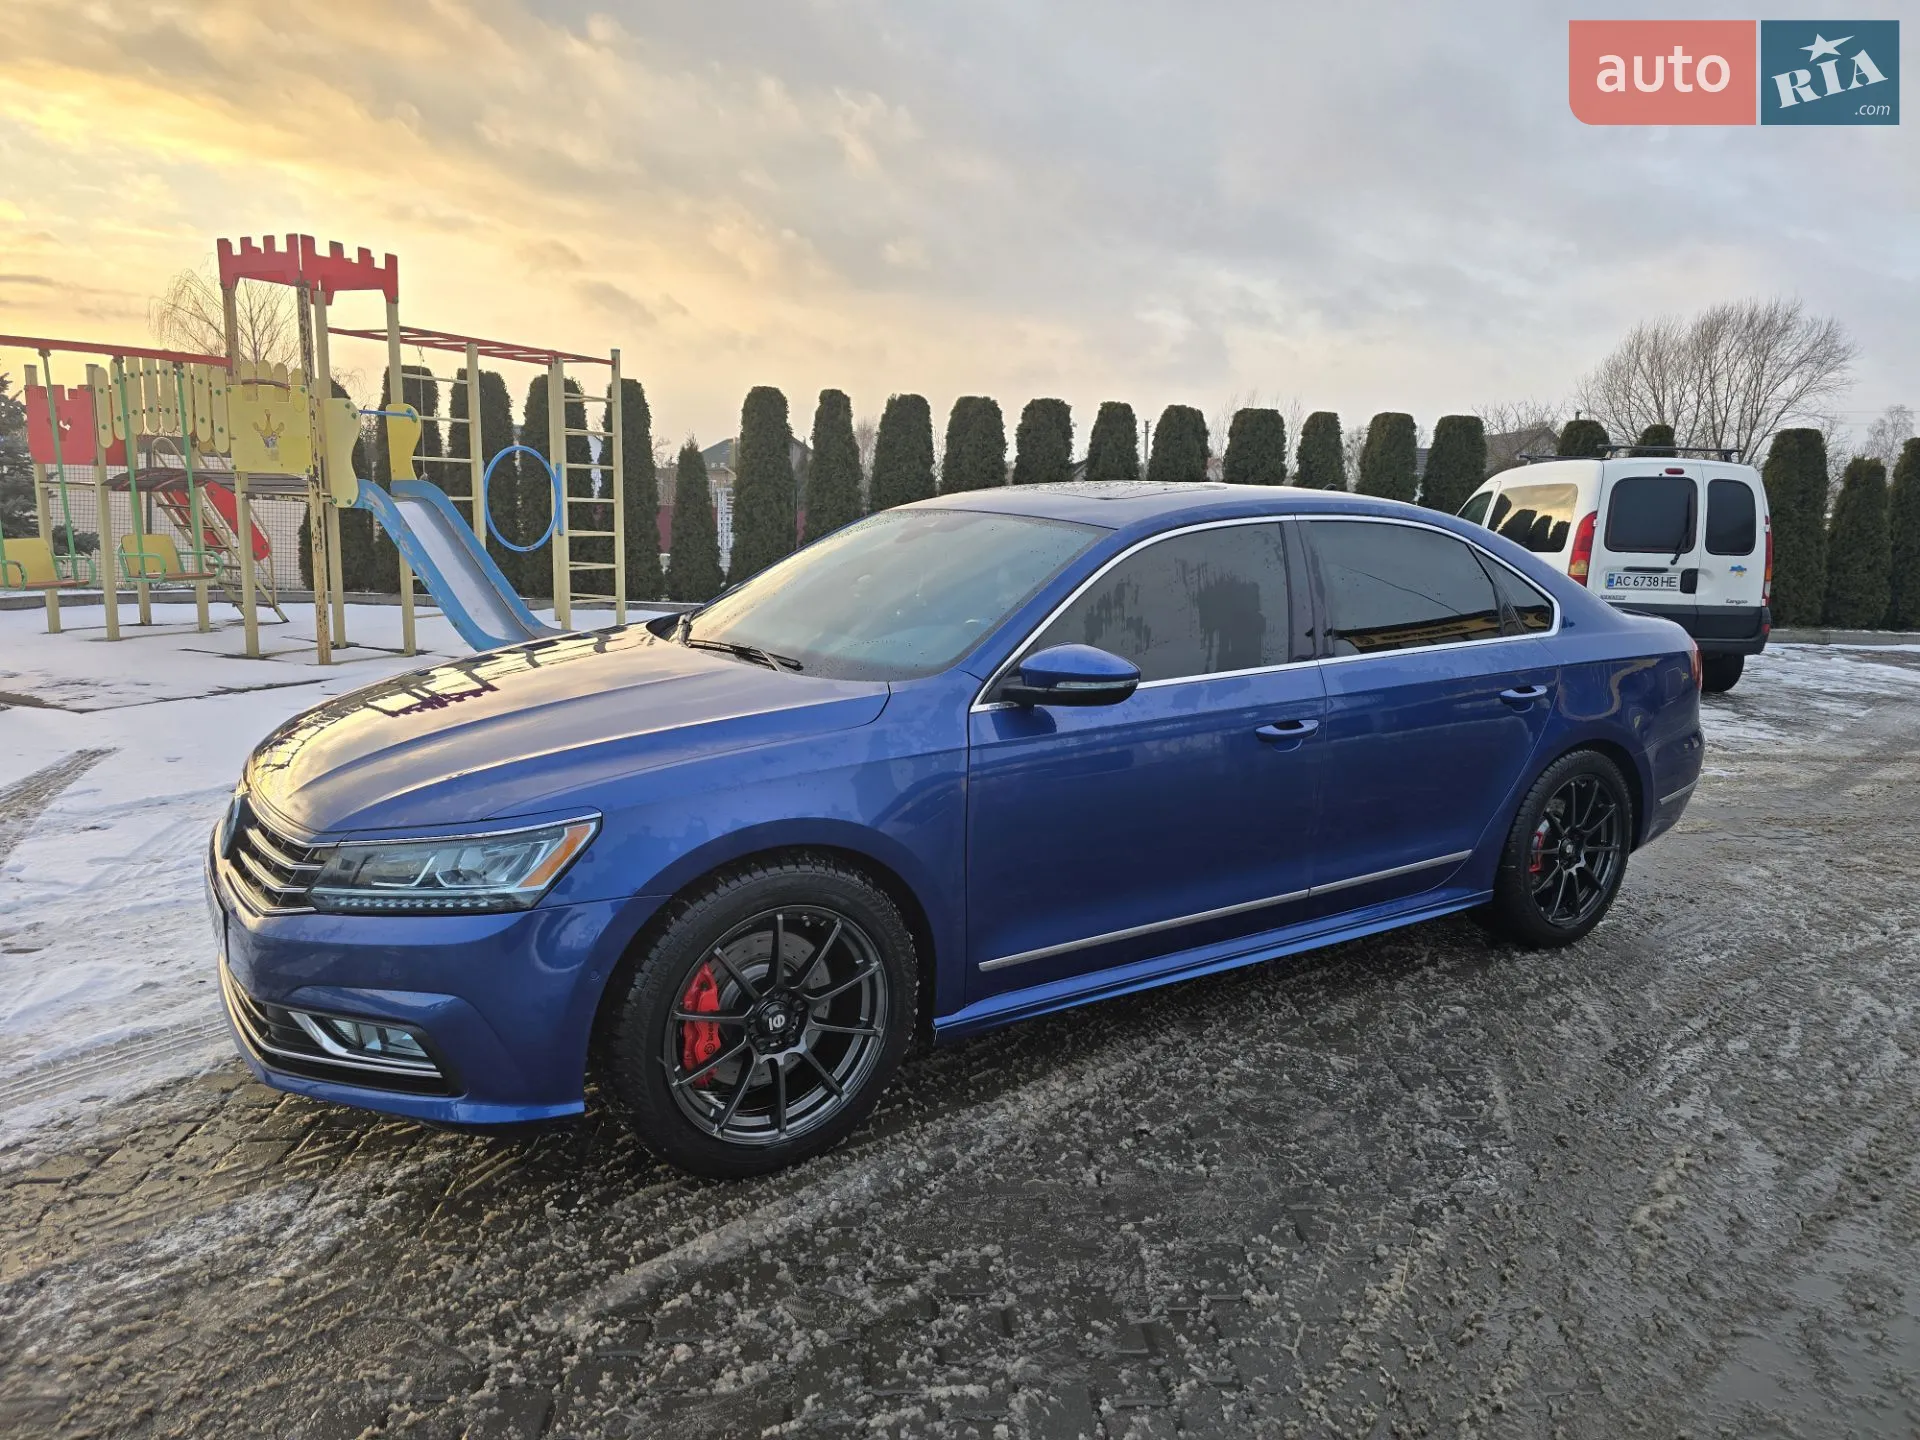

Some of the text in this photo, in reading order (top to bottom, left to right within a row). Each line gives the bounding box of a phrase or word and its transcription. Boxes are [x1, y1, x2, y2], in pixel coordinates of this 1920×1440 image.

[1615, 576, 1678, 588] AC 6738 HE
